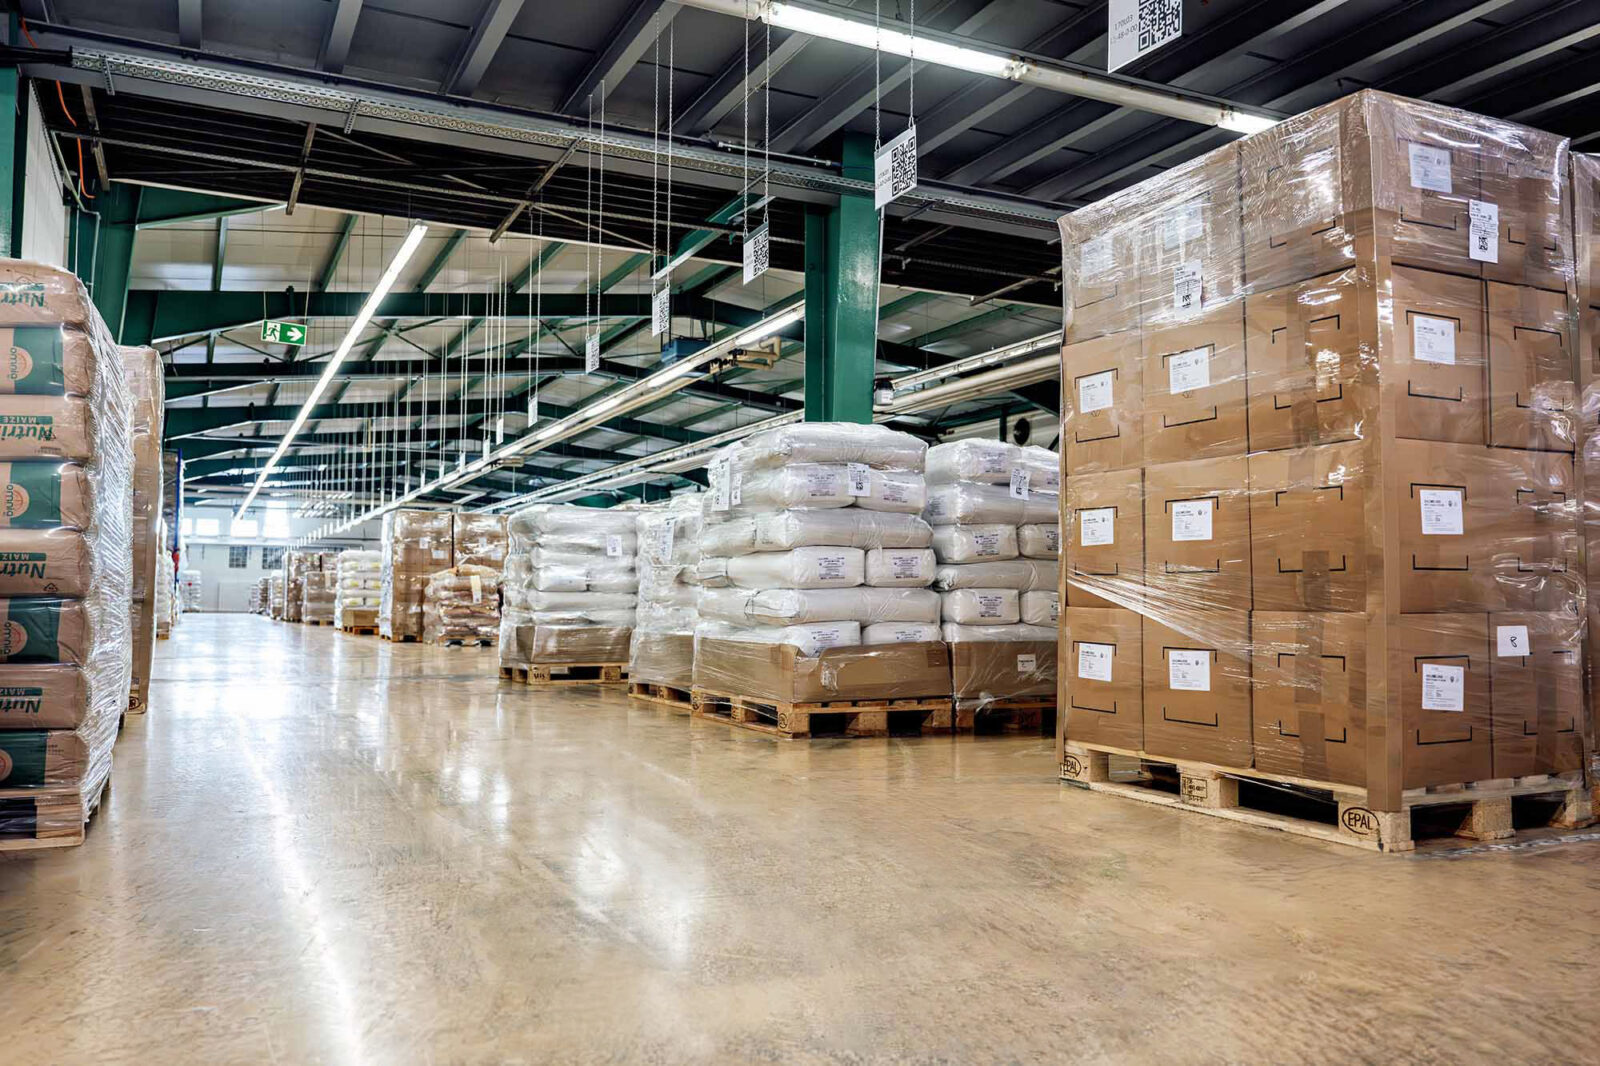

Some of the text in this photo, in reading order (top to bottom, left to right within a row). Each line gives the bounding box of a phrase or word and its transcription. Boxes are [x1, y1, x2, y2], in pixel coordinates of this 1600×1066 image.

[3, 416, 37, 424] MAIZE
[0, 426, 53, 442] Nutri
[1347, 811, 1373, 830] EPAL
